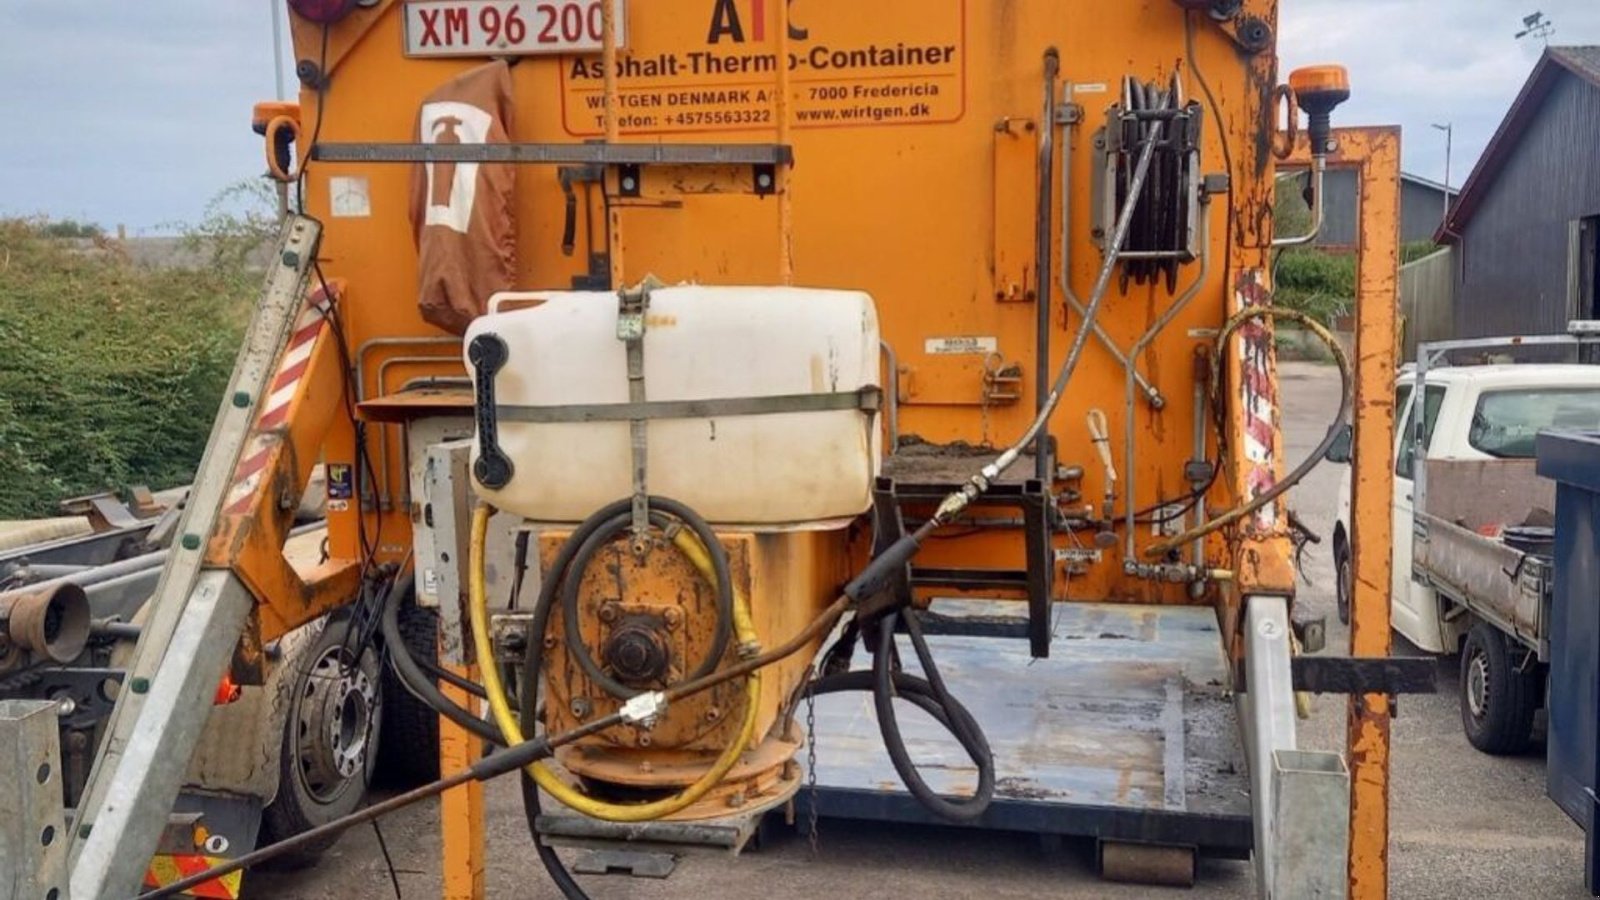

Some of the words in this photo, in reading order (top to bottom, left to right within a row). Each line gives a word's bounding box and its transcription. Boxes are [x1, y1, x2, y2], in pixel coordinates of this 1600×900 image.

[419, 7, 469, 47] XM
[479, 5, 526, 46] 96
[536, 3, 603, 44] 200
[586, 92, 661, 110] WITGEN
[667, 89, 750, 107] DENMARK
[809, 86, 848, 100] 7000
[853, 83, 939, 98] Fredericia
[596, 113, 658, 128] Tefon:
[664, 109, 770, 126] +4575563322
[796, 103, 930, 121] www.wirtgen.dk
